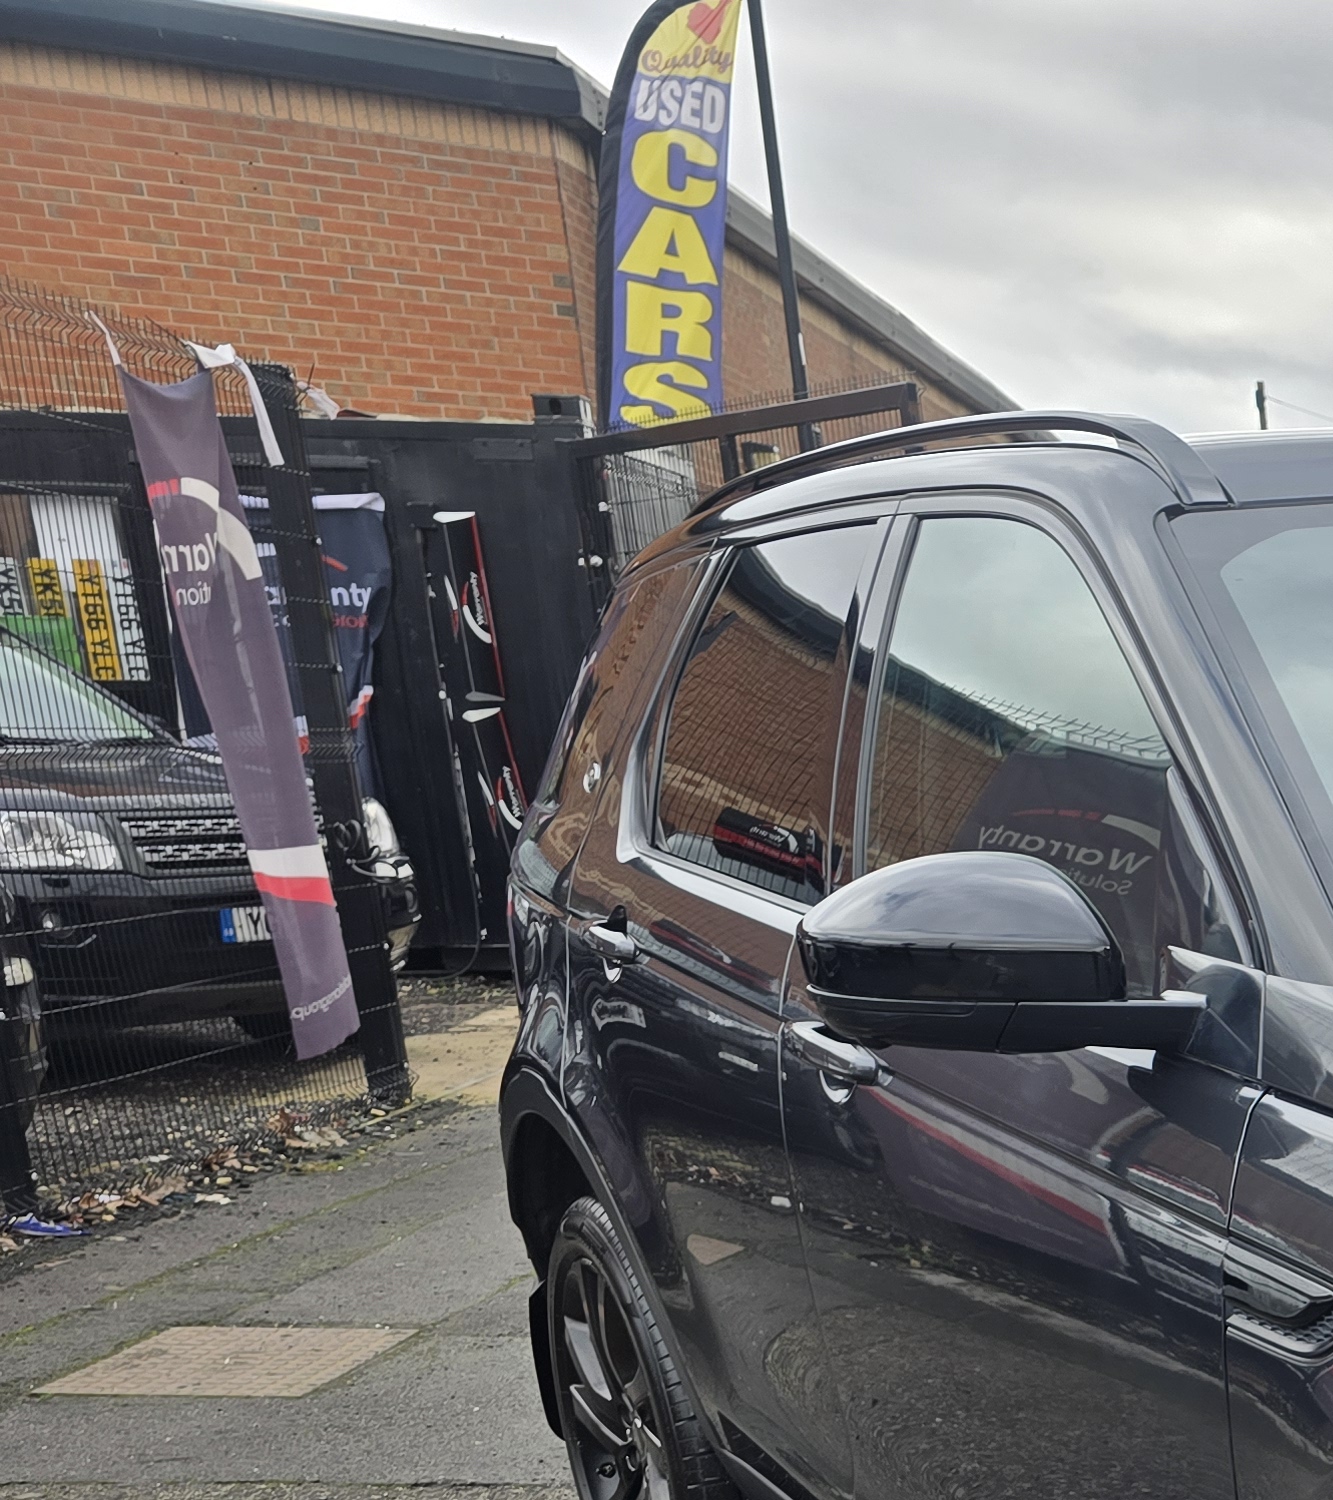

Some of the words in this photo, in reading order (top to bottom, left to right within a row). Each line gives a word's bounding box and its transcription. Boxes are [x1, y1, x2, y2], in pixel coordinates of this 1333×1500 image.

[641, 45, 734, 79] Quality
[634, 77, 726, 135] USED
[617, 128, 719, 429] CARS
